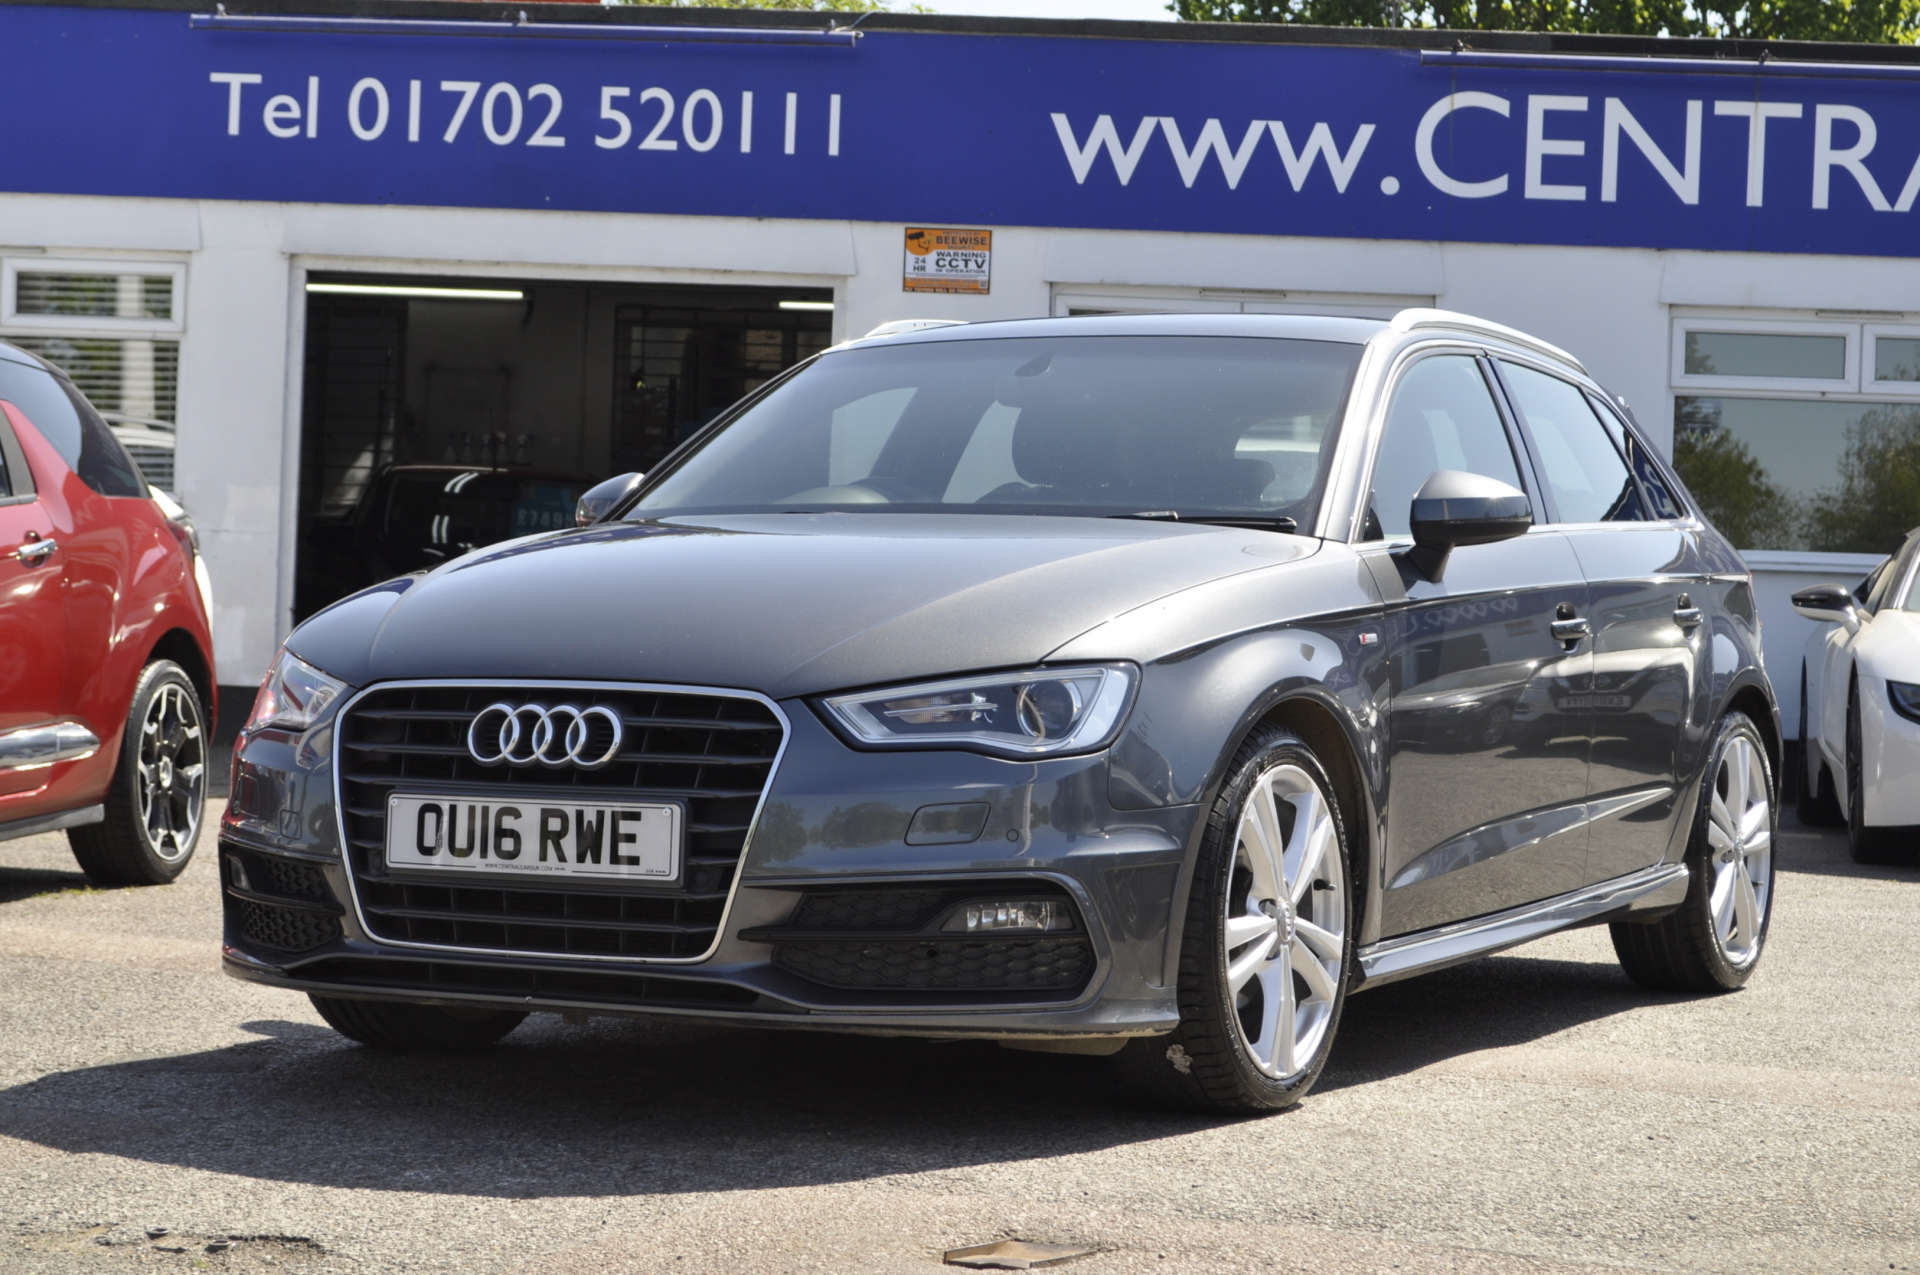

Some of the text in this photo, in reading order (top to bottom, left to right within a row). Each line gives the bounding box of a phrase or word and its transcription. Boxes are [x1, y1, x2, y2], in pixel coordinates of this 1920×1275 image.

[209, 72, 841, 156] Tel 01702 520111
[936, 235, 987, 245] BEEWISE
[936, 250, 986, 258] WARNING
[935, 258, 986, 269] CCTV
[416, 802, 642, 866] OU16 RWE
